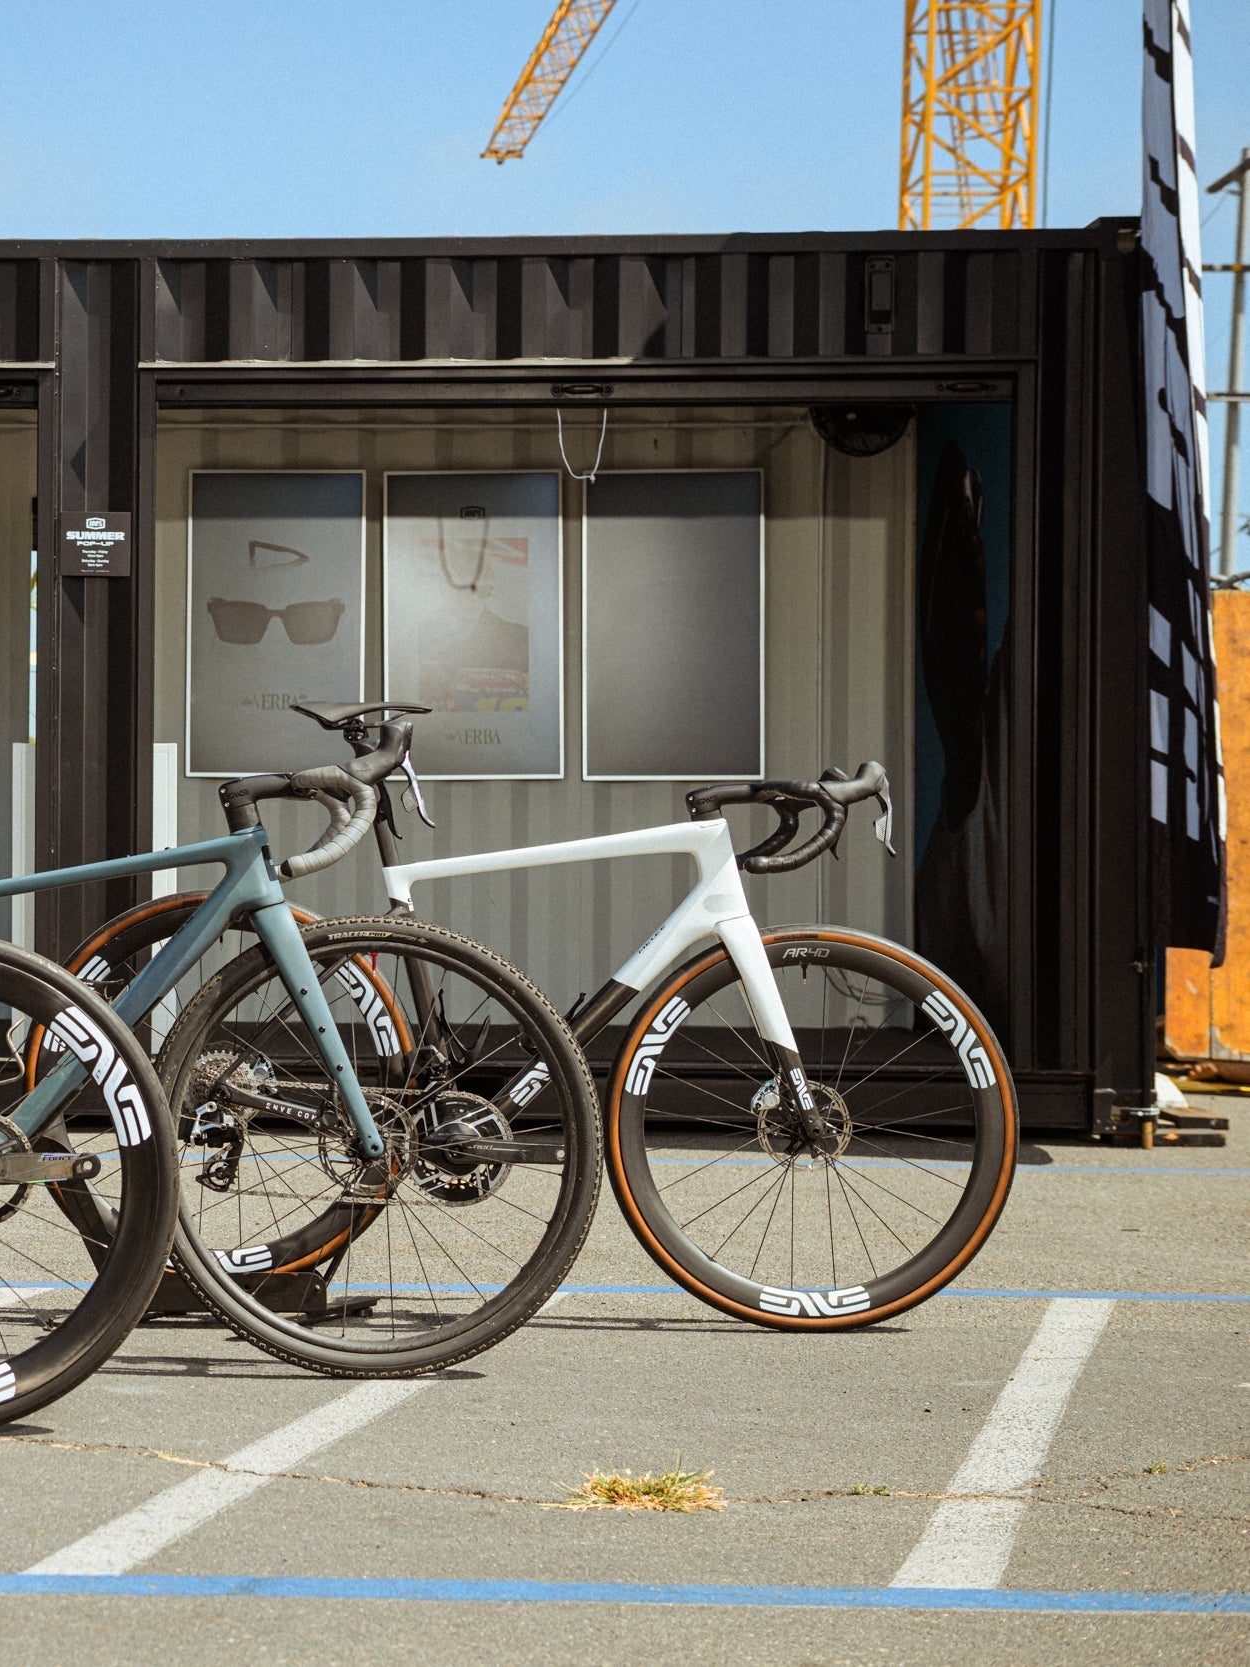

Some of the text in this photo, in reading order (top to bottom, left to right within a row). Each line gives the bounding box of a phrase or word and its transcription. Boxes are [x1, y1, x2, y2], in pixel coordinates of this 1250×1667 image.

[66, 531, 125, 540] SUMMER
[625, 996, 691, 1096] ENVE
[921, 990, 997, 1089] ENVE
[50, 1006, 152, 1147] ENVE
[265, 1102, 292, 1114] ENVE
[759, 1285, 870, 1316] ENVE
